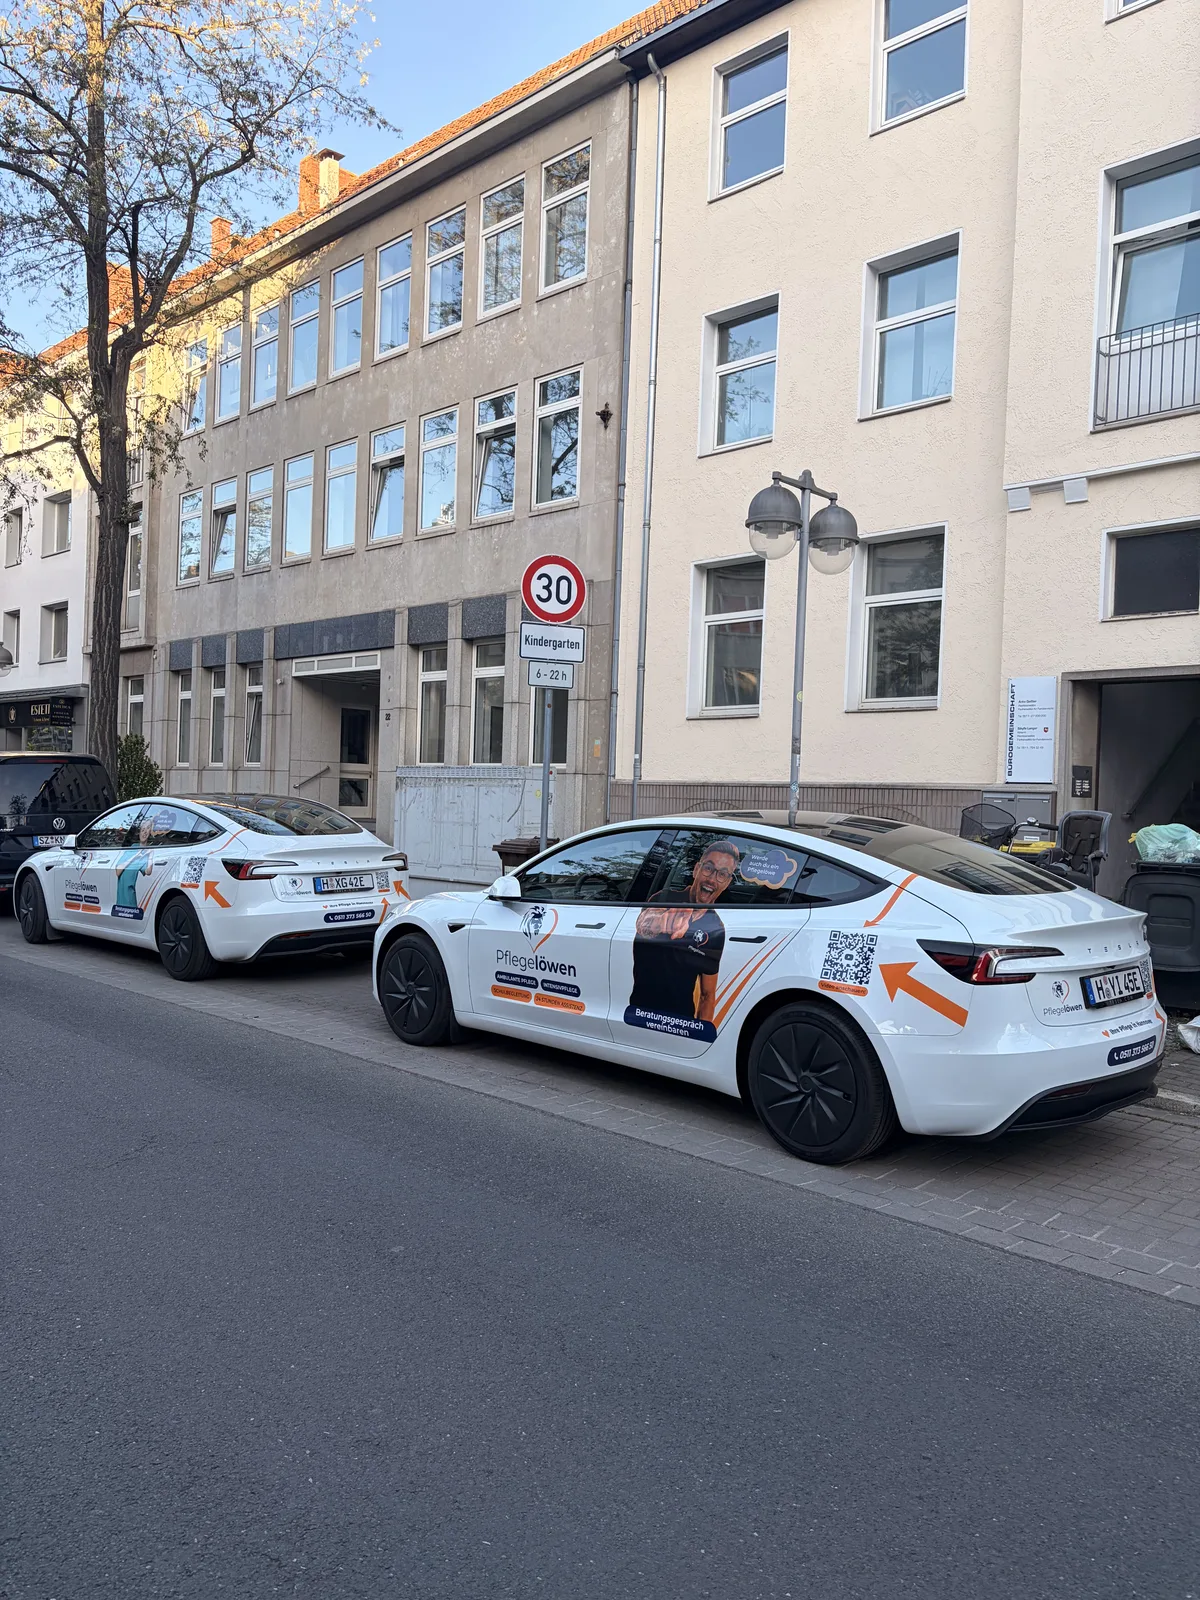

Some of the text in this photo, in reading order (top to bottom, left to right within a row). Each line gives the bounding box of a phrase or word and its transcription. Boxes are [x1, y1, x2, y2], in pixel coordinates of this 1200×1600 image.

[536, 573, 572, 605] 30
[524, 635, 580, 650] Kindergarten
[536, 669, 541, 678] 6
[549, 670, 559, 680] 22
[561, 672, 567, 680] h
[1007, 683, 1016, 777] BÜROGEMEINSCHAFT
[39, 837, 50, 845] SZ
[65, 879, 98, 893] Pflegelöwen
[322, 876, 365, 890] H XG 42E
[1088, 940, 1139, 954] TESLA
[496, 949, 577, 977] Pflegelöwen
[496, 973, 537, 986] AMBULANTE PFLEGE
[1095, 972, 1140, 1000] H YI 45E
[493, 988, 530, 999] SCHULBEGLEITUNG
[543, 982, 578, 994] INTENSIVPFLEGE
[541, 997, 561, 1006] STUNDEN
[560, 1001, 583, 1012] ASSISTENZ
[1043, 1004, 1083, 1016] Pflegelöwen
[635, 1008, 704, 1030] Beratungsgespräch
[646, 1021, 689, 1036] vereinbaren
[1120, 1049, 1132, 1059] 0511
